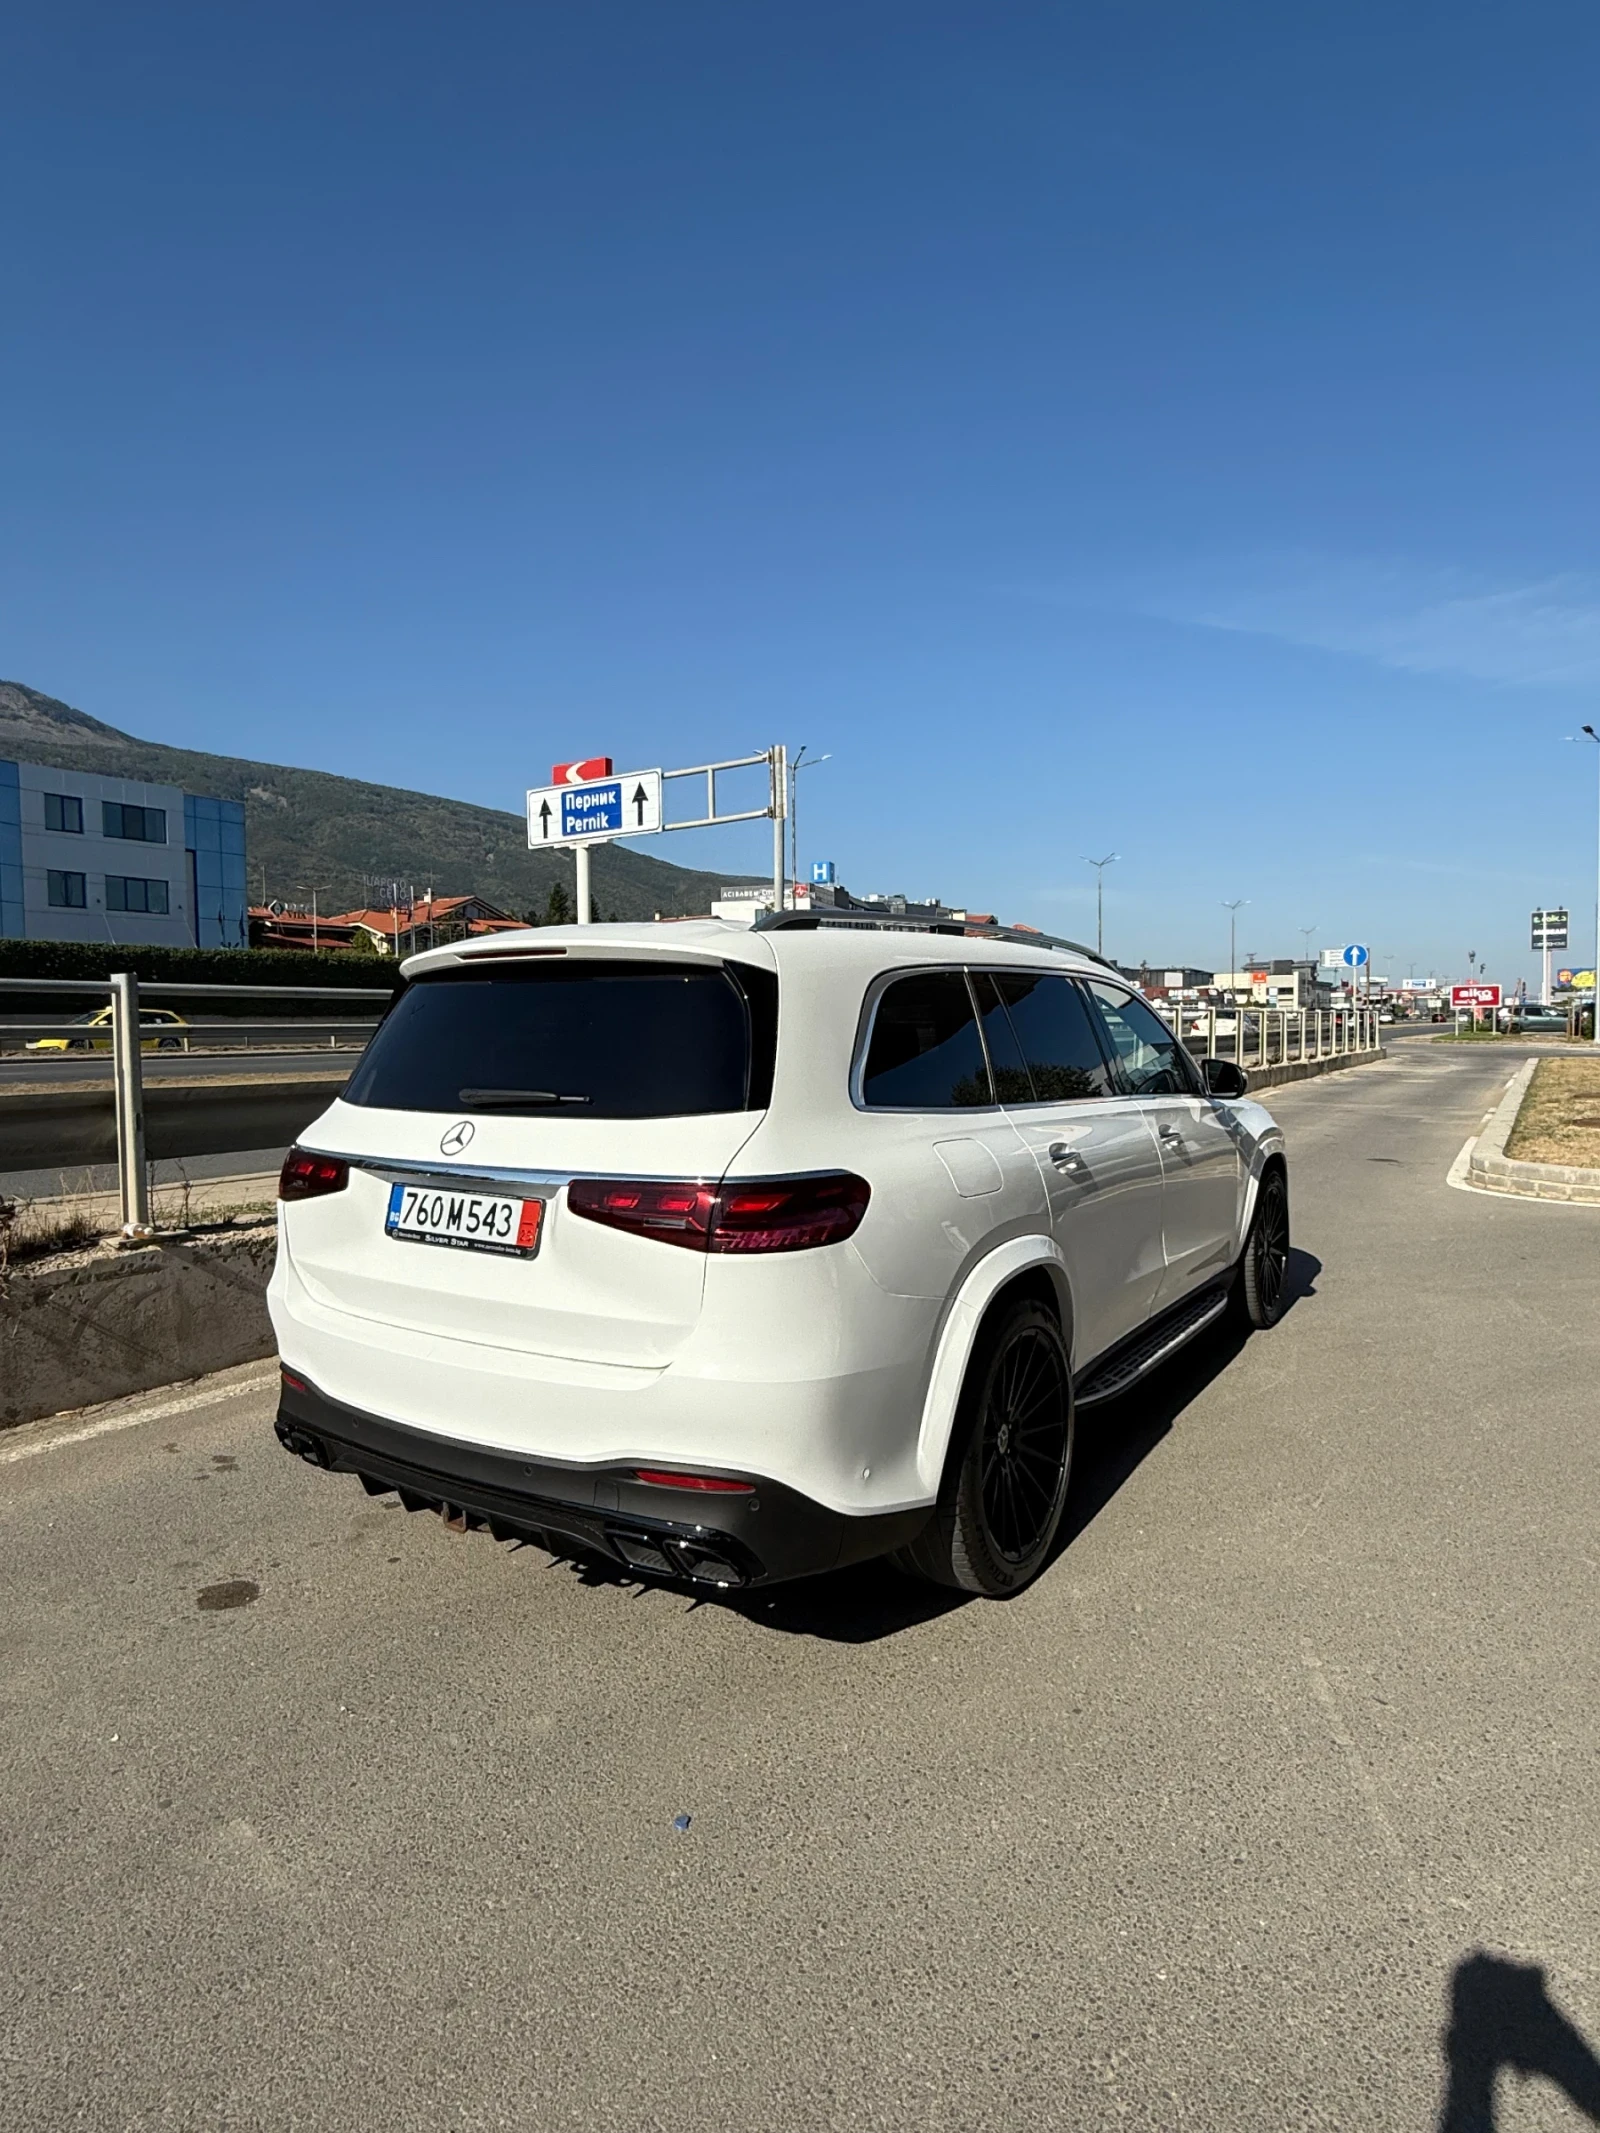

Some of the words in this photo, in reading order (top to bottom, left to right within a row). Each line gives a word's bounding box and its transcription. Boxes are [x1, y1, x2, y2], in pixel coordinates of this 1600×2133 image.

[565, 790, 616, 811] Перник
[566, 812, 609, 833] Pernik
[813, 863, 827, 881] H
[389, 1211, 400, 1222] BG
[402, 1192, 513, 1238] 760M543
